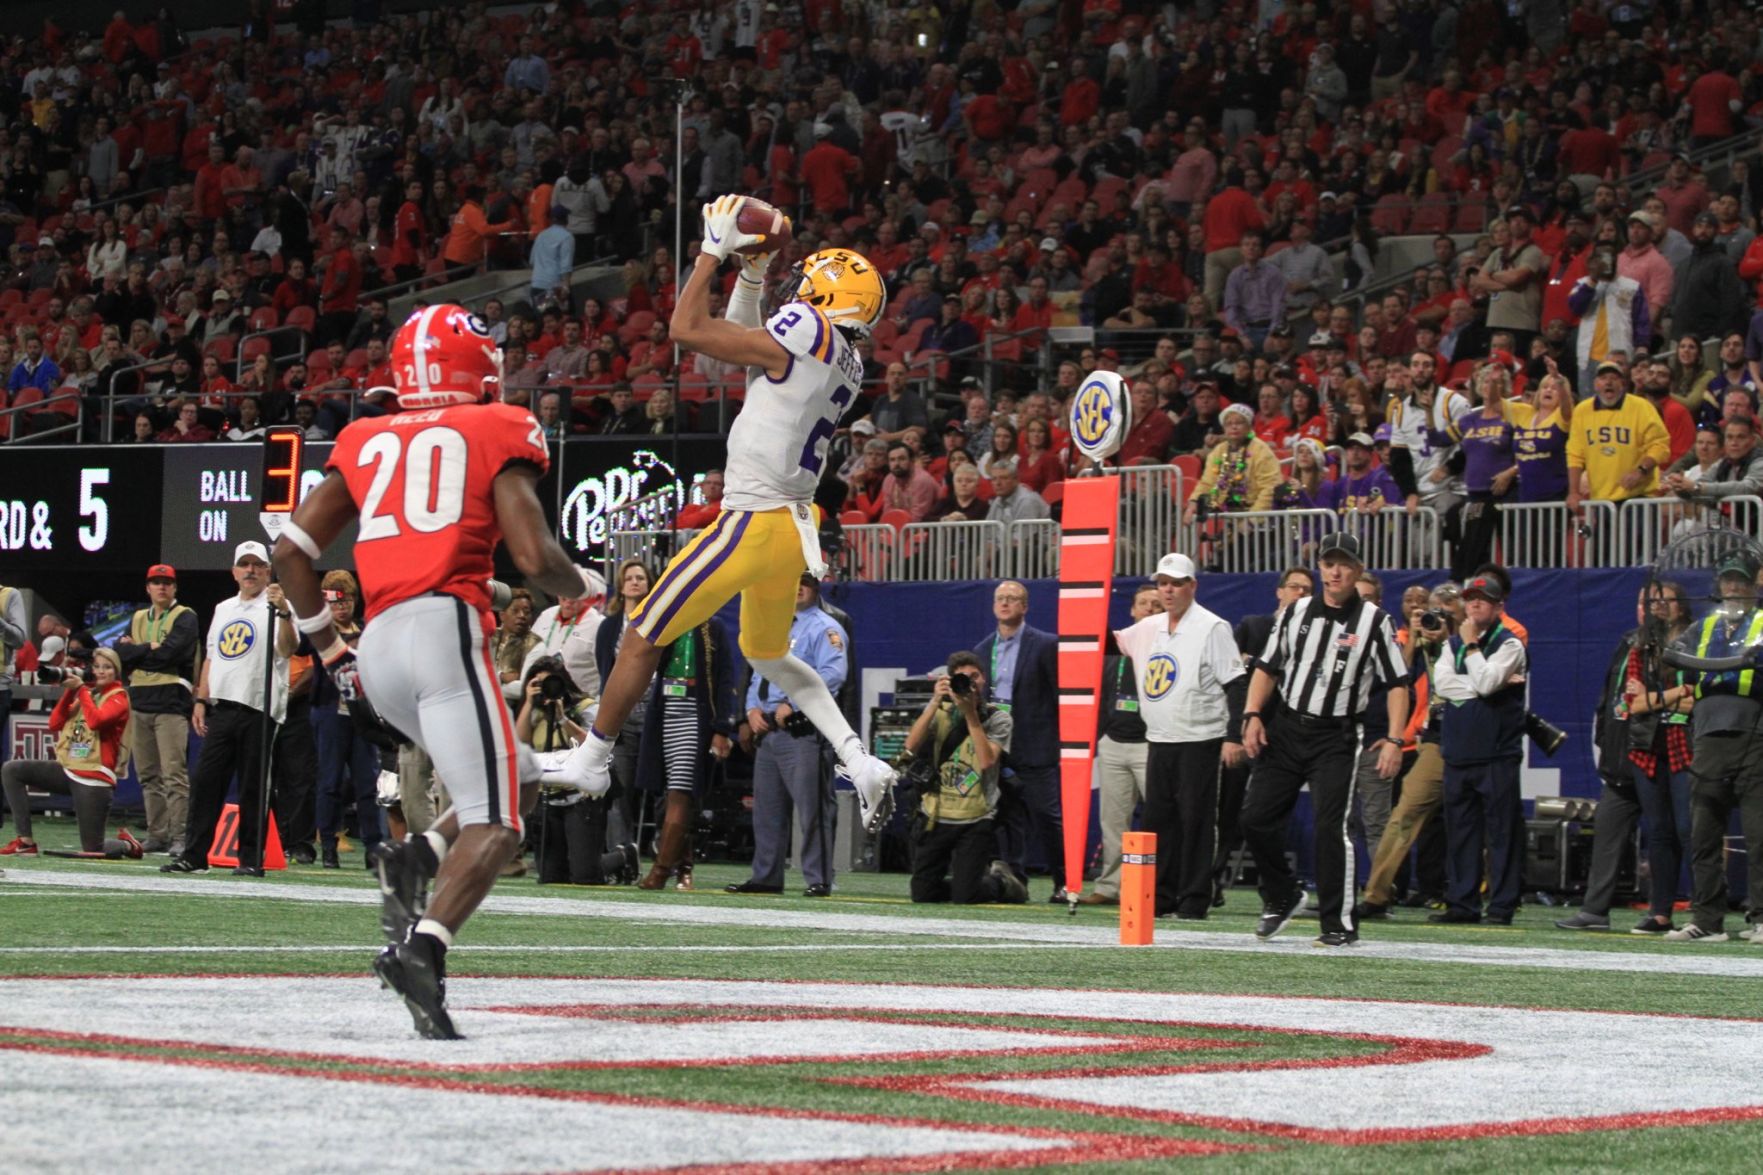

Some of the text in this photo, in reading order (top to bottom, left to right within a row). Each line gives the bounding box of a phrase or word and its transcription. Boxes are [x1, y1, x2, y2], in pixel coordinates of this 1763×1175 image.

[815, 251, 868, 275] LSU
[774, 311, 802, 337] 2
[798, 384, 853, 477] 2
[1076, 386, 1110, 441] SEC
[526, 415, 550, 459] 2
[1464, 425, 1504, 439] LSU
[1513, 431, 1552, 440] LSU
[1586, 426, 1631, 446] LSU
[200, 469, 253, 502] BALL
[264, 433, 299, 512] 3
[357, 426, 468, 543] 20
[78, 467, 110, 552] 5
[199, 509, 228, 542] ON
[219, 623, 254, 658] SEC
[1145, 659, 1175, 696] SEC
[1335, 660, 1346, 673] F
